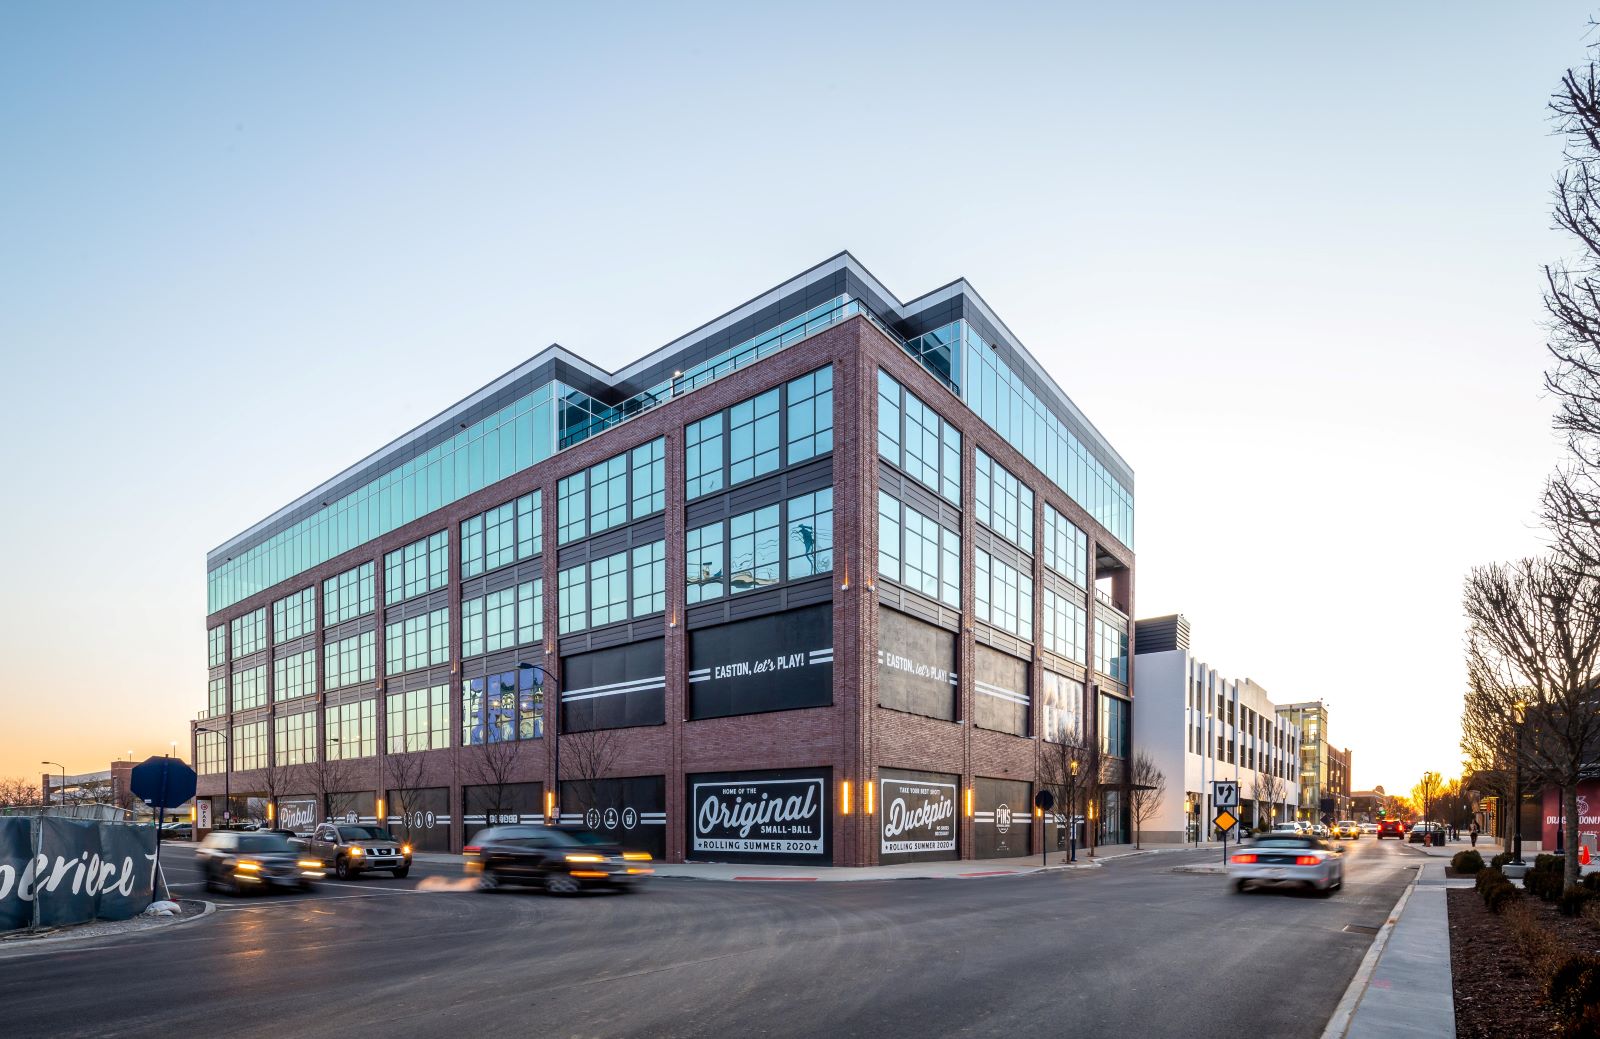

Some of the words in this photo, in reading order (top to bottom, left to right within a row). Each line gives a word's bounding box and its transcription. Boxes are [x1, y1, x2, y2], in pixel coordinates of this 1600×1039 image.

[715, 662, 752, 679] EASTON,
[753, 658, 776, 674] let's
[777, 653, 804, 670] PLAY!
[886, 652, 915, 674] EASTON,
[930, 666, 948, 682] PLAY!
[280, 803, 315, 830] Pinball
[698, 785, 817, 838] Original
[885, 795, 953, 837] Duckpin
[760, 825, 813, 834] SMALL-BALL
[703, 841, 740, 850] ROLLING
[744, 841, 782, 851] SUMMER
[786, 842, 811, 851] 2020
[889, 843, 913, 851] ROLLING
[914, 842, 936, 850] SUMMER
[937, 841, 950, 849] 2020
